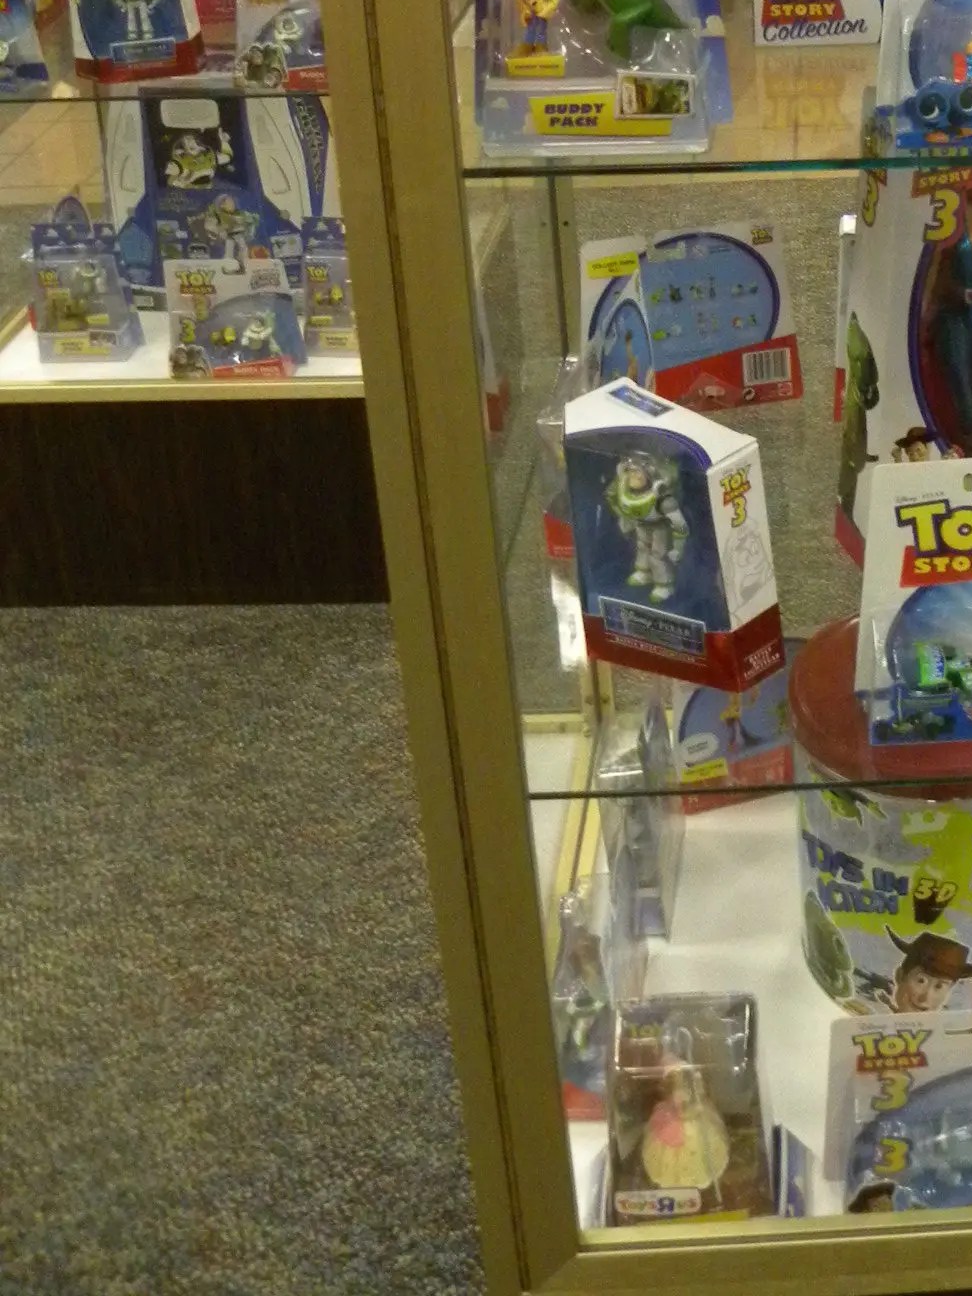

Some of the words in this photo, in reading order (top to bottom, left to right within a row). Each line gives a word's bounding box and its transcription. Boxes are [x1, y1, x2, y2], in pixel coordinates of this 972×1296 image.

[770, 3, 837, 18] STORY
[762, 16, 868, 43] Collection
[543, 103, 605, 115] BUDDY
[549, 116, 598, 128] PACK
[919, 168, 972, 186] STORY
[922, 188, 961, 243] 3
[719, 463, 752, 492] TOY
[730, 495, 748, 529] 3
[852, 1029, 933, 1059] TOY
[870, 1069, 915, 1112] 3
[873, 1136, 913, 1175] 3
